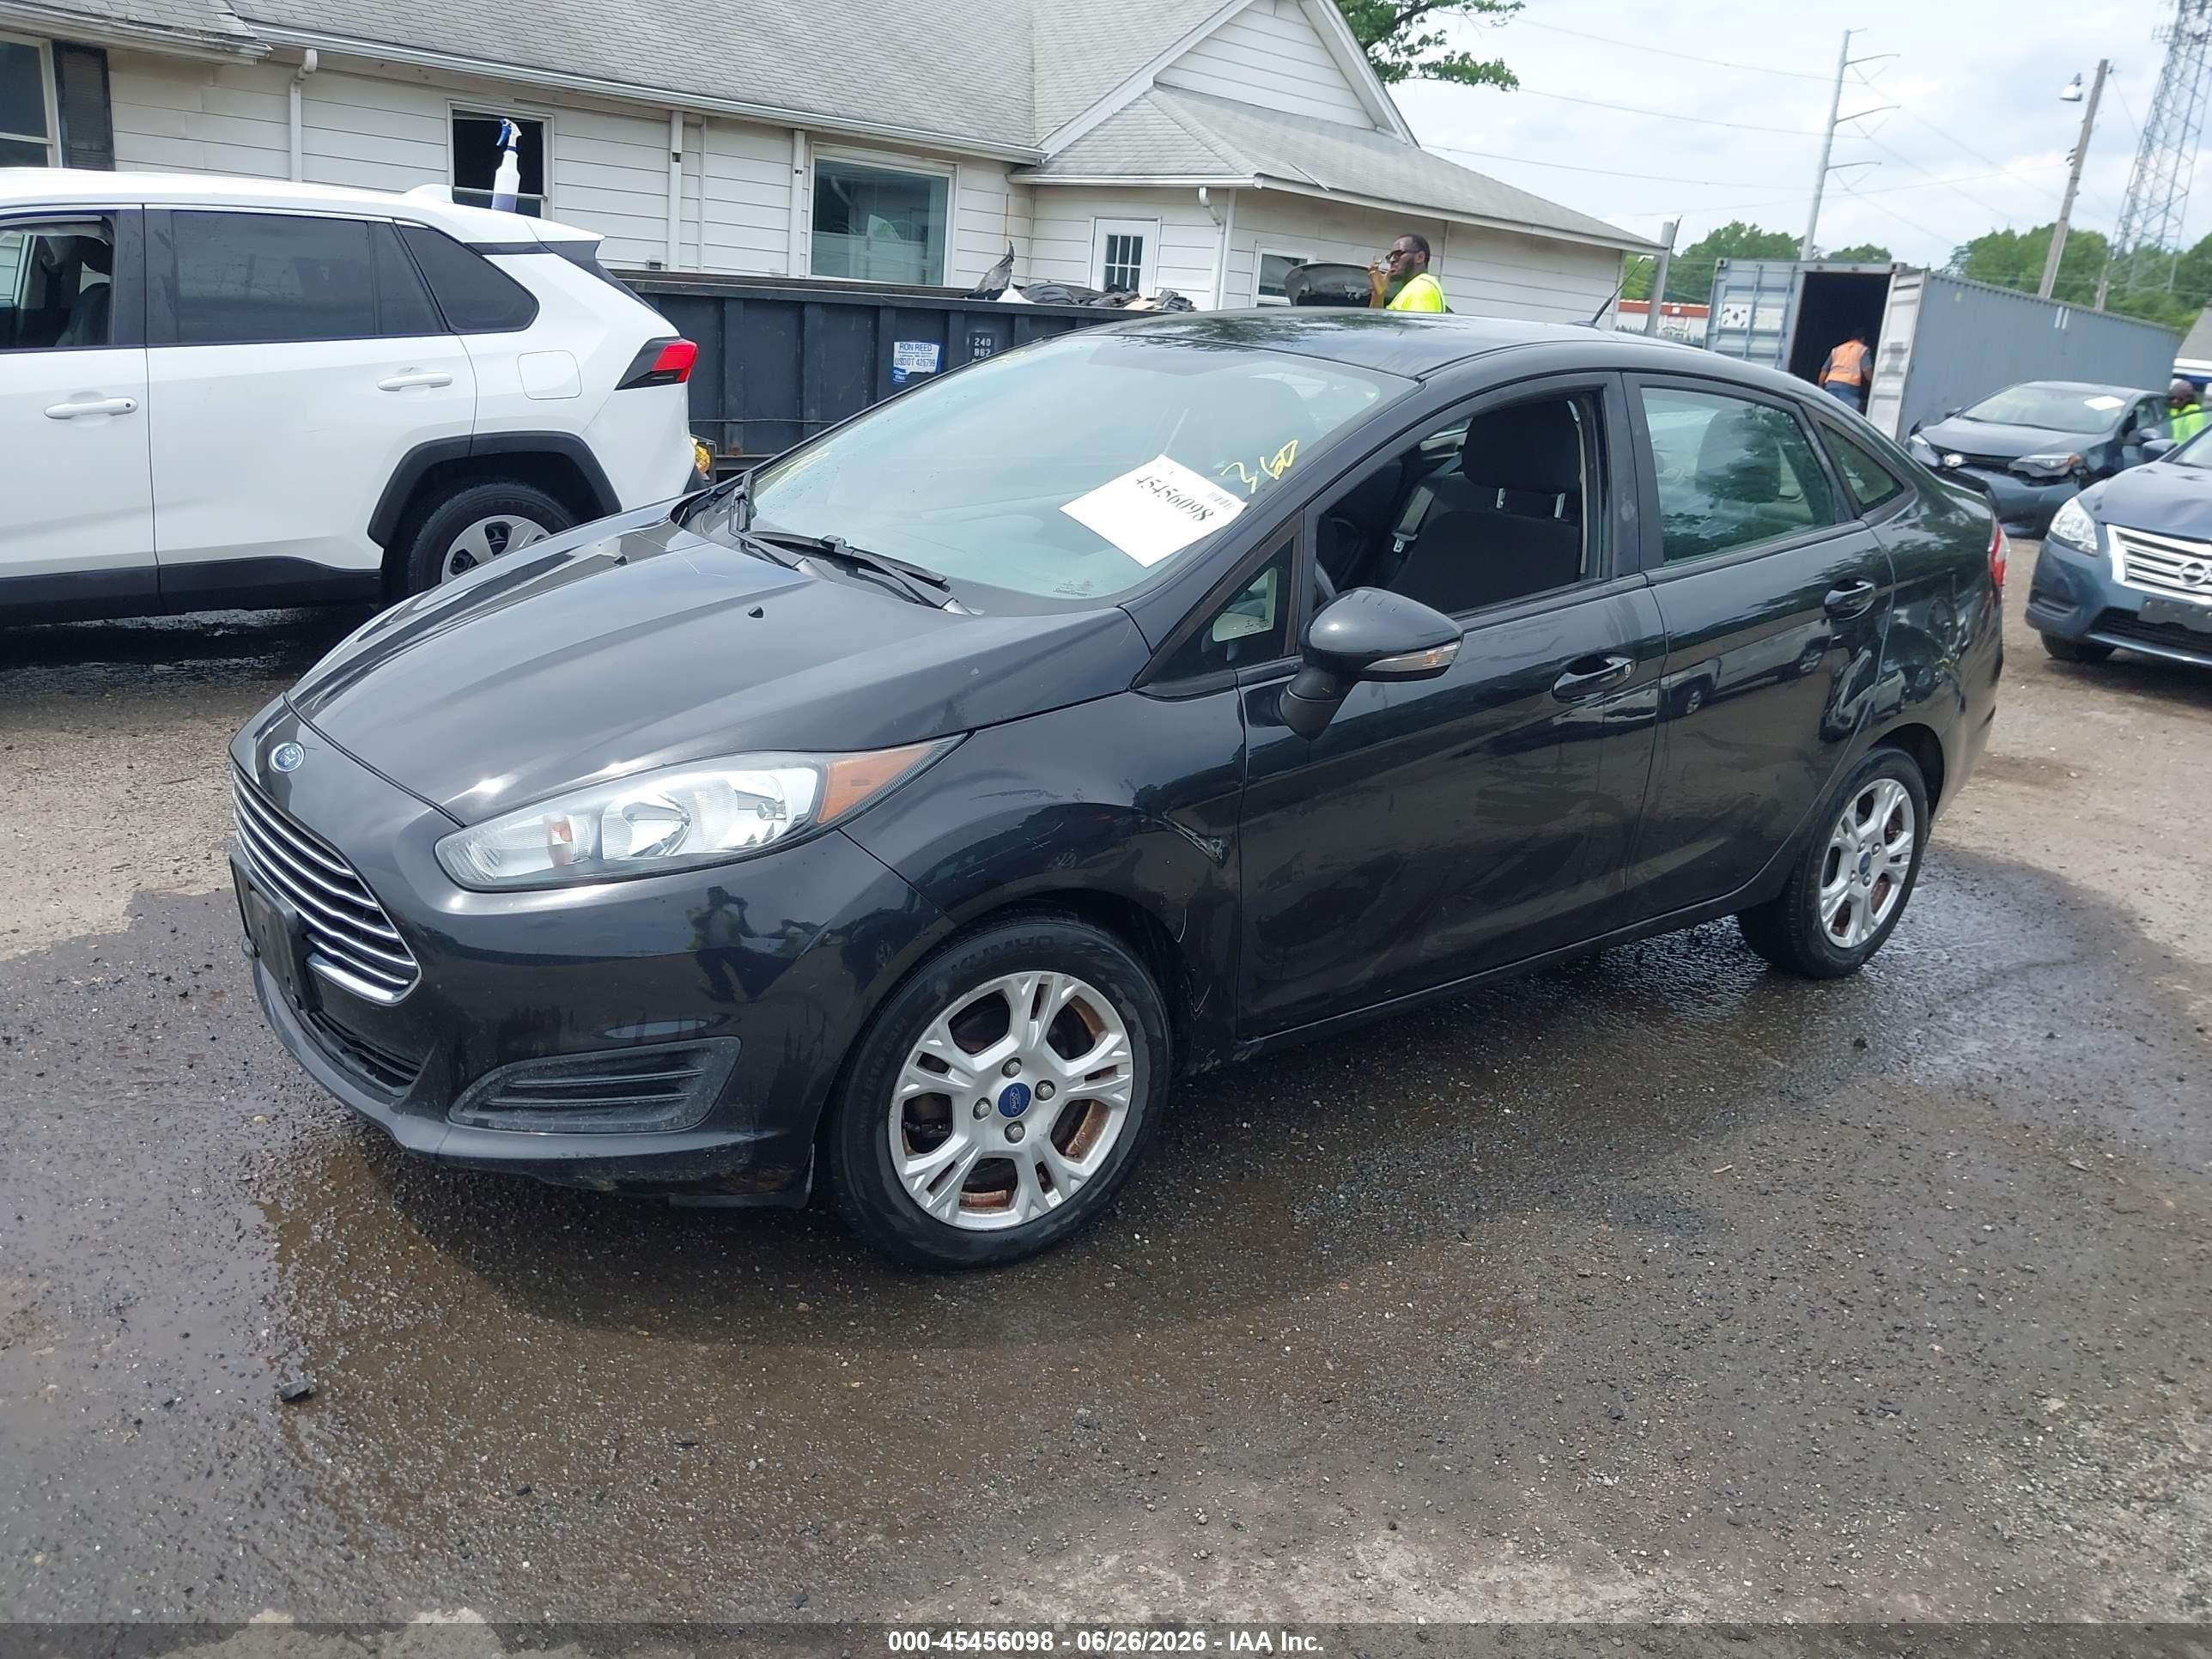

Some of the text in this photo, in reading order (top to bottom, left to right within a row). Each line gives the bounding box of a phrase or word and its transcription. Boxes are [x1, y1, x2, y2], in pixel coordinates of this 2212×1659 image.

[975, 337, 992, 347] 240
[899, 343, 933, 352] RON REED
